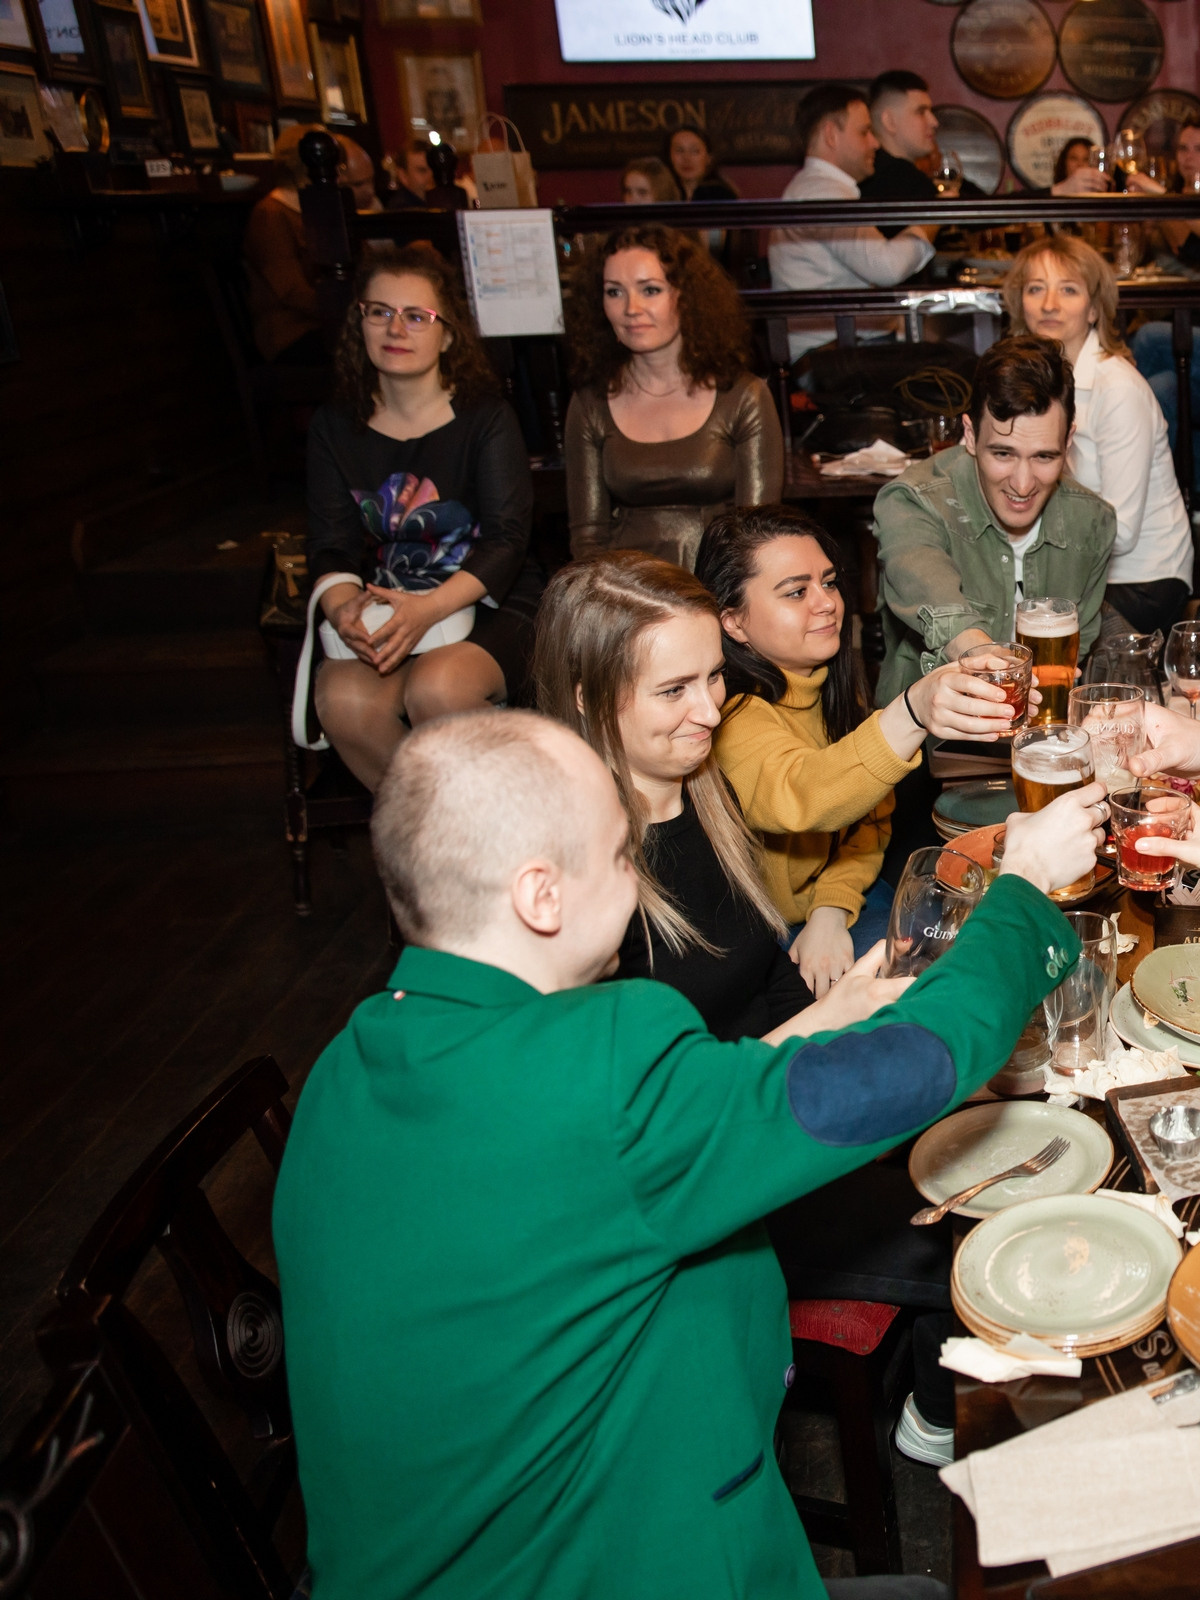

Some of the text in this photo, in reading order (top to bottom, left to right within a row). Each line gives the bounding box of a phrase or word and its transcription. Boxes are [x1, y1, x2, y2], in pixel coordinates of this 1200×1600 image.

[615, 32, 759, 46] LION'S HEAD CLUB
[542, 100, 706, 144] JAMESON
